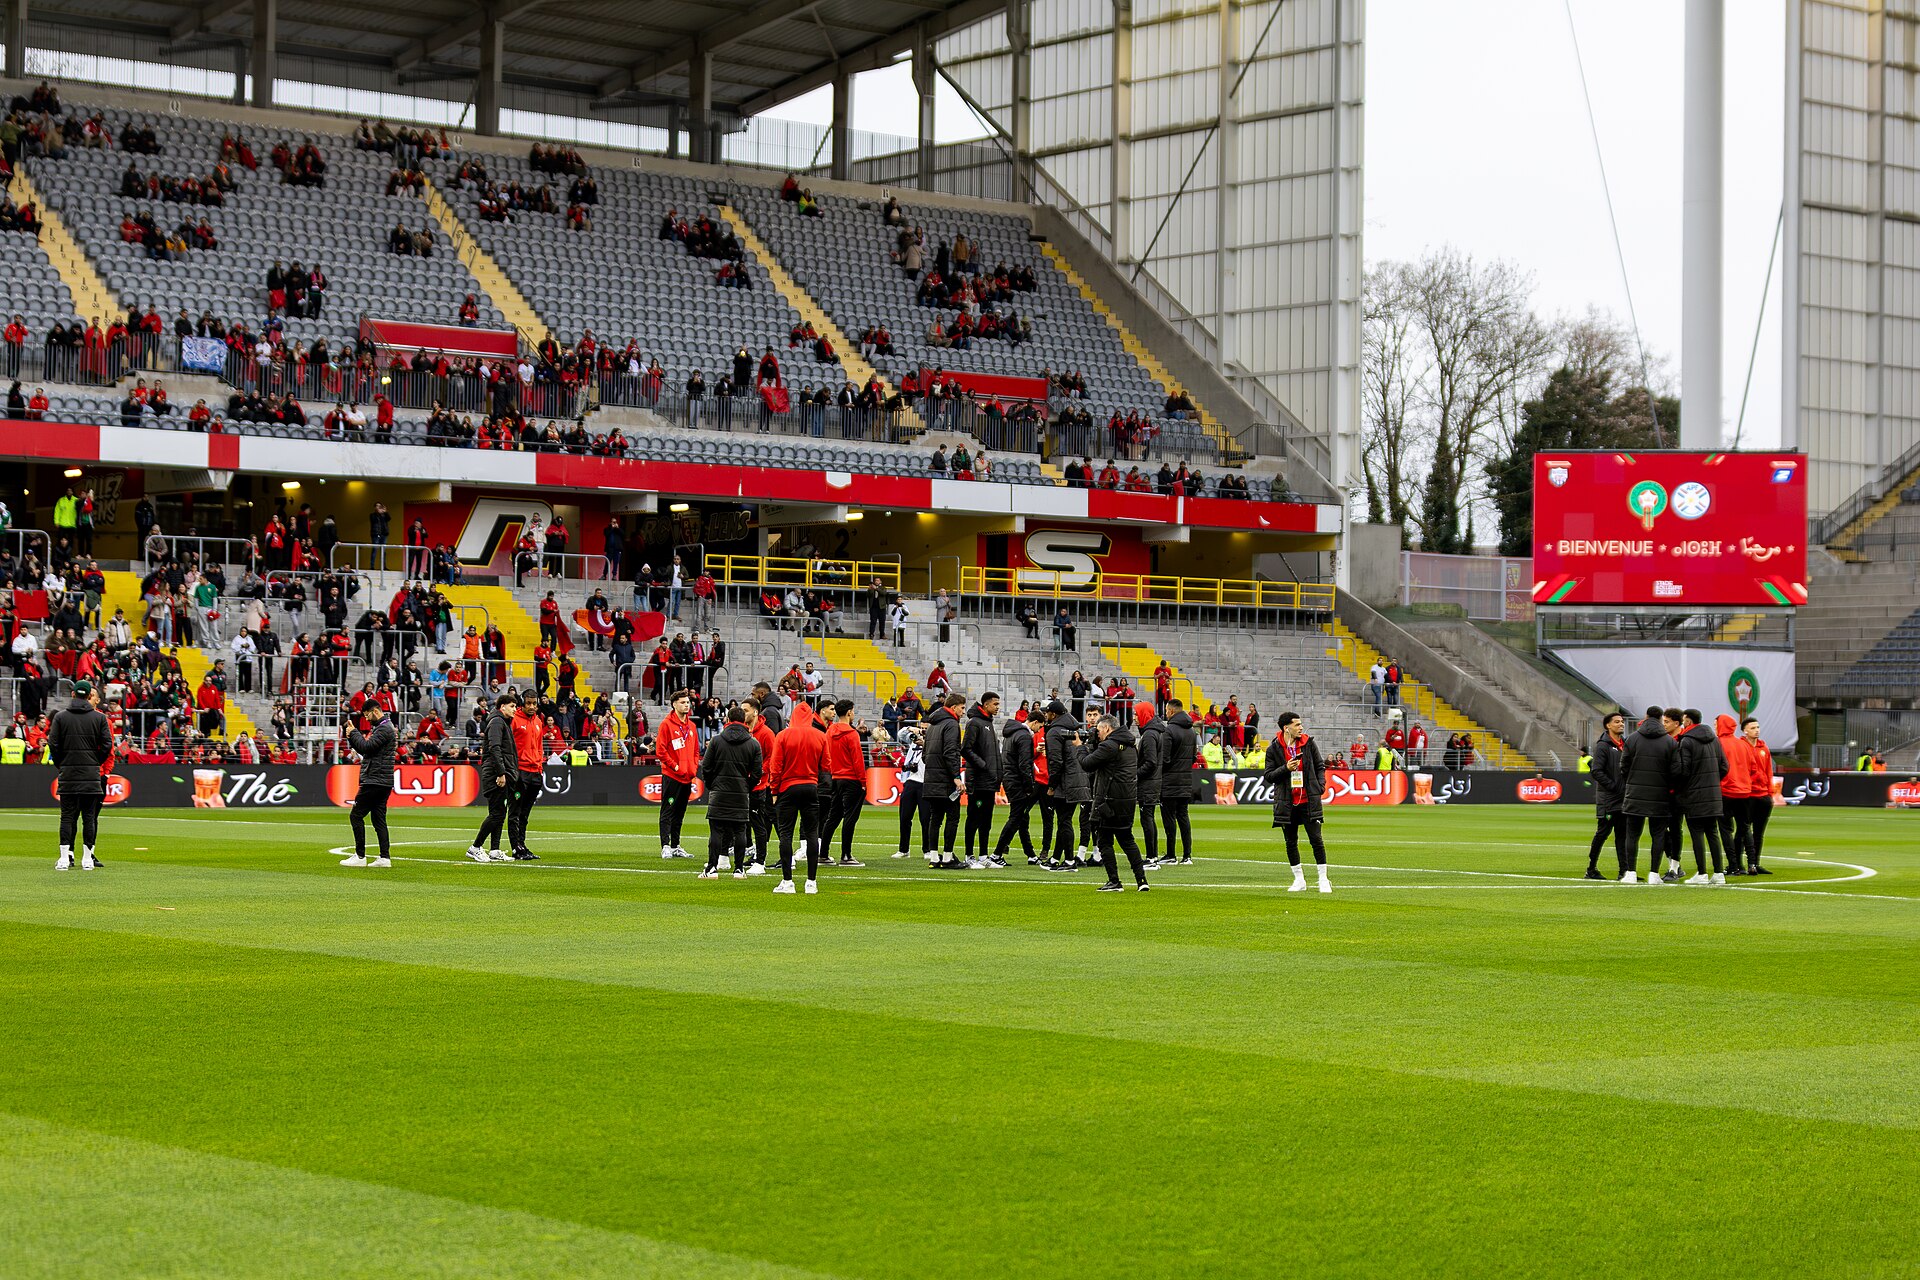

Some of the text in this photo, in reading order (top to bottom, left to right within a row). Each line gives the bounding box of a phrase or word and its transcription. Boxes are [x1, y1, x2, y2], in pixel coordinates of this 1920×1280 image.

[708, 510, 752, 542] LENS
[1558, 540, 1653, 554] BIENVENUE
[226, 772, 291, 804] Thé
[644, 783, 697, 794] BER
[1521, 786, 1557, 795] BELLAR
